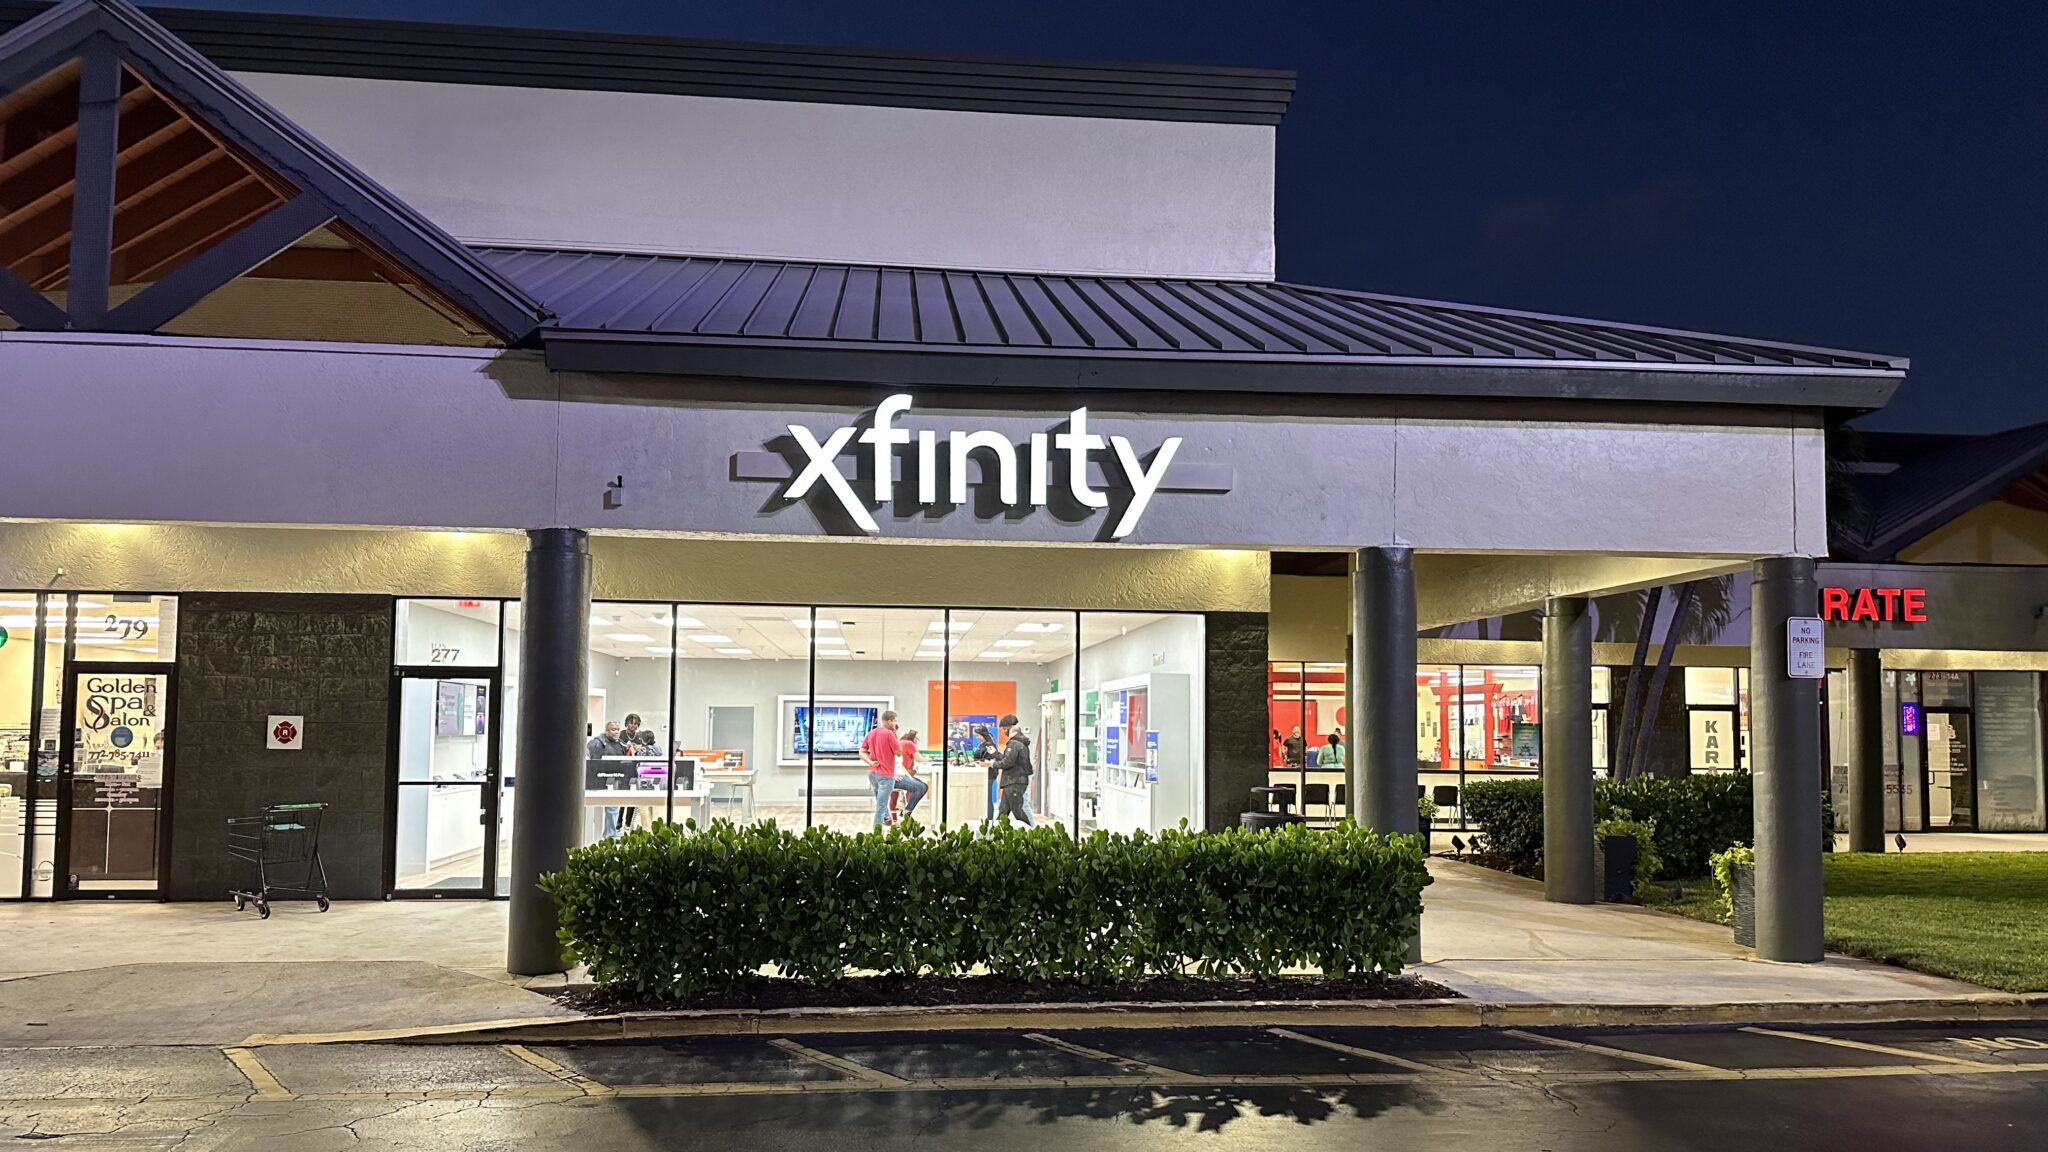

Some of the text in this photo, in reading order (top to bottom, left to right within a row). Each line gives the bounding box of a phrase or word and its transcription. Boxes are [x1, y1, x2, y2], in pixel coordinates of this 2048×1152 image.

[784, 394, 1182, 538] xfinity
[1822, 587, 1927, 622] RATE
[105, 615, 148, 639] 279
[1792, 636, 1820, 644] PARKING
[431, 648, 460, 662] 277
[1799, 651, 1814, 659] FIRE
[87, 677, 157, 693] Golden
[86, 694, 156, 716] Spa &
[84, 711, 150, 733] Salon
